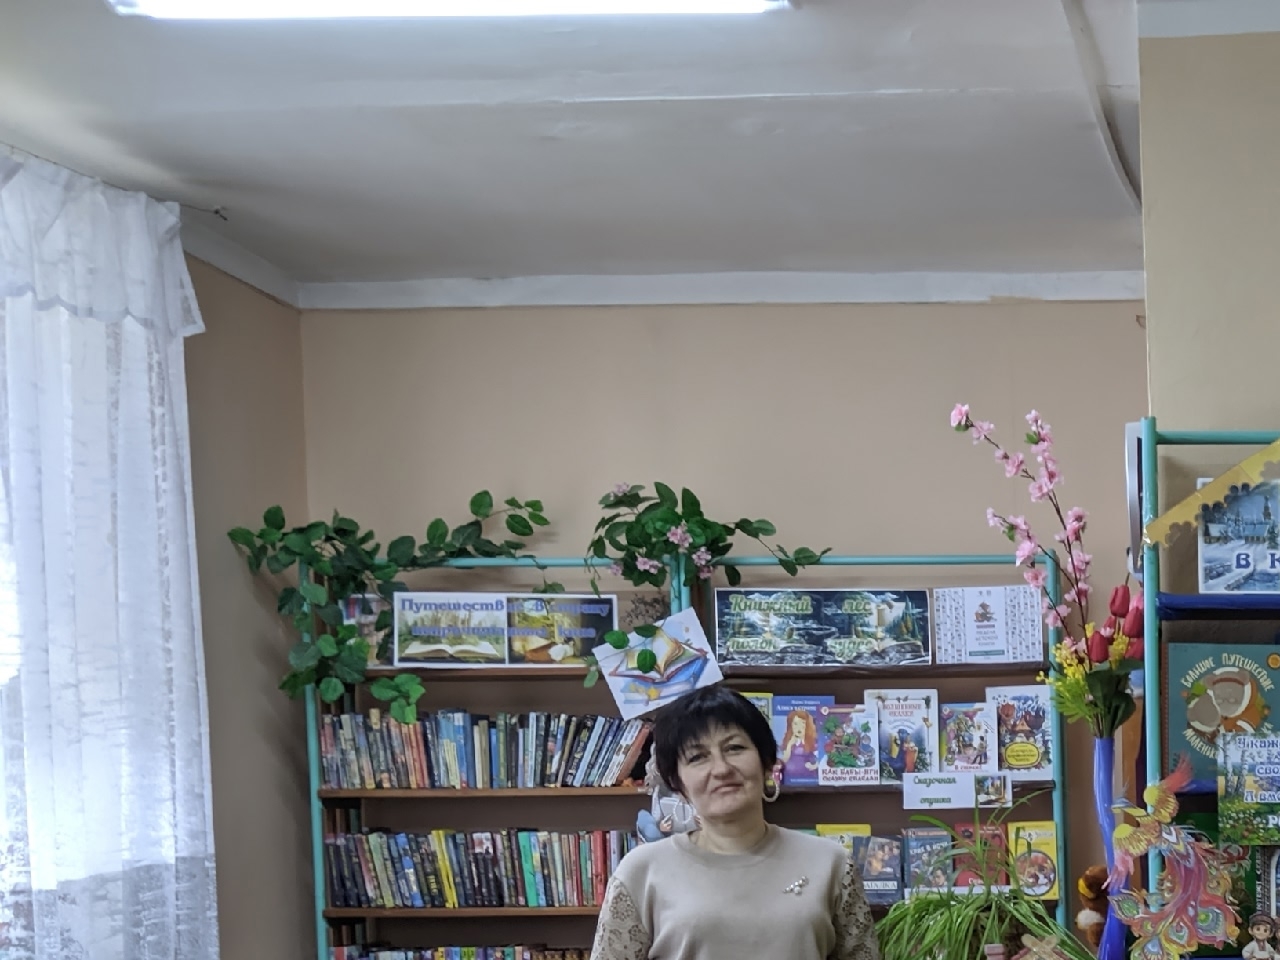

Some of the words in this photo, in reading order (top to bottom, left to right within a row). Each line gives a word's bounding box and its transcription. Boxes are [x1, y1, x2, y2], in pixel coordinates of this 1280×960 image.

[1234, 550, 1251, 569] в
[1181, 727, 1219, 759] МАЛЕНЬК
[913, 776, 956, 787] Сказочная
